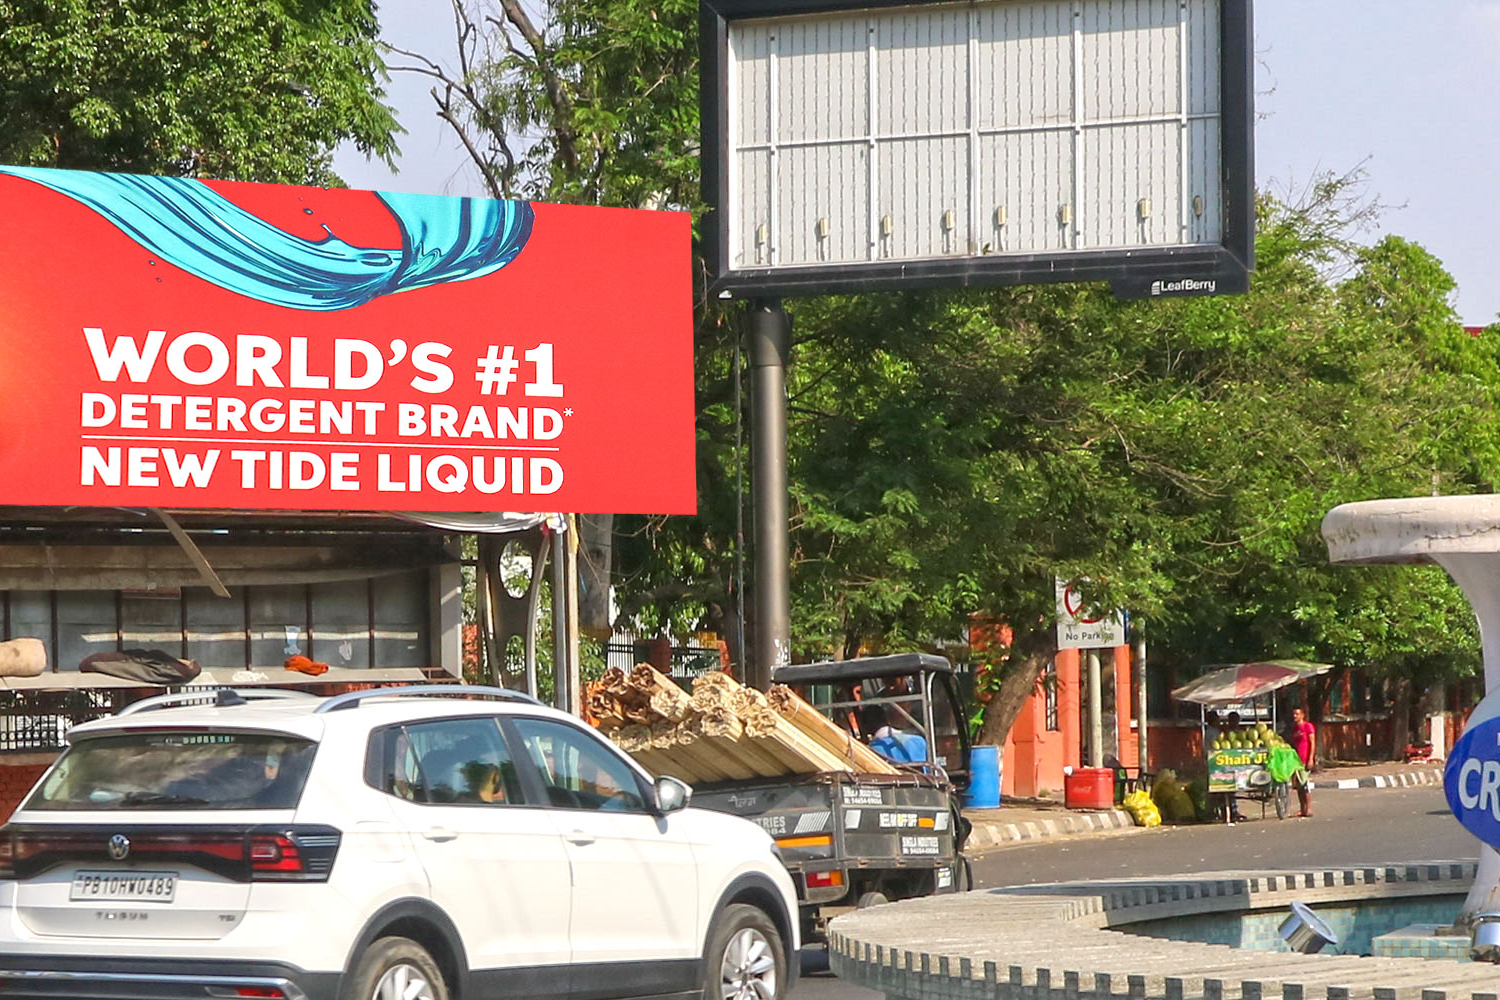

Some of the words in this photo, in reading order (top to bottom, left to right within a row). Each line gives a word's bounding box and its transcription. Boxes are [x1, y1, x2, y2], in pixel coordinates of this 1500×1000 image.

[1160, 279, 1216, 292] LeafBerry
[82, 327, 455, 394] WORLD’S
[475, 342, 564, 397] #1
[81, 392, 386, 435] DETERGENT
[81, 446, 221, 488] NEW
[231, 450, 360, 491] TIDE
[377, 453, 564, 494] LIQUID
[1065, 632, 1079, 641] No
[1215, 754, 1251, 766] Shah
[81, 875, 175, 896] PB10HW0489
